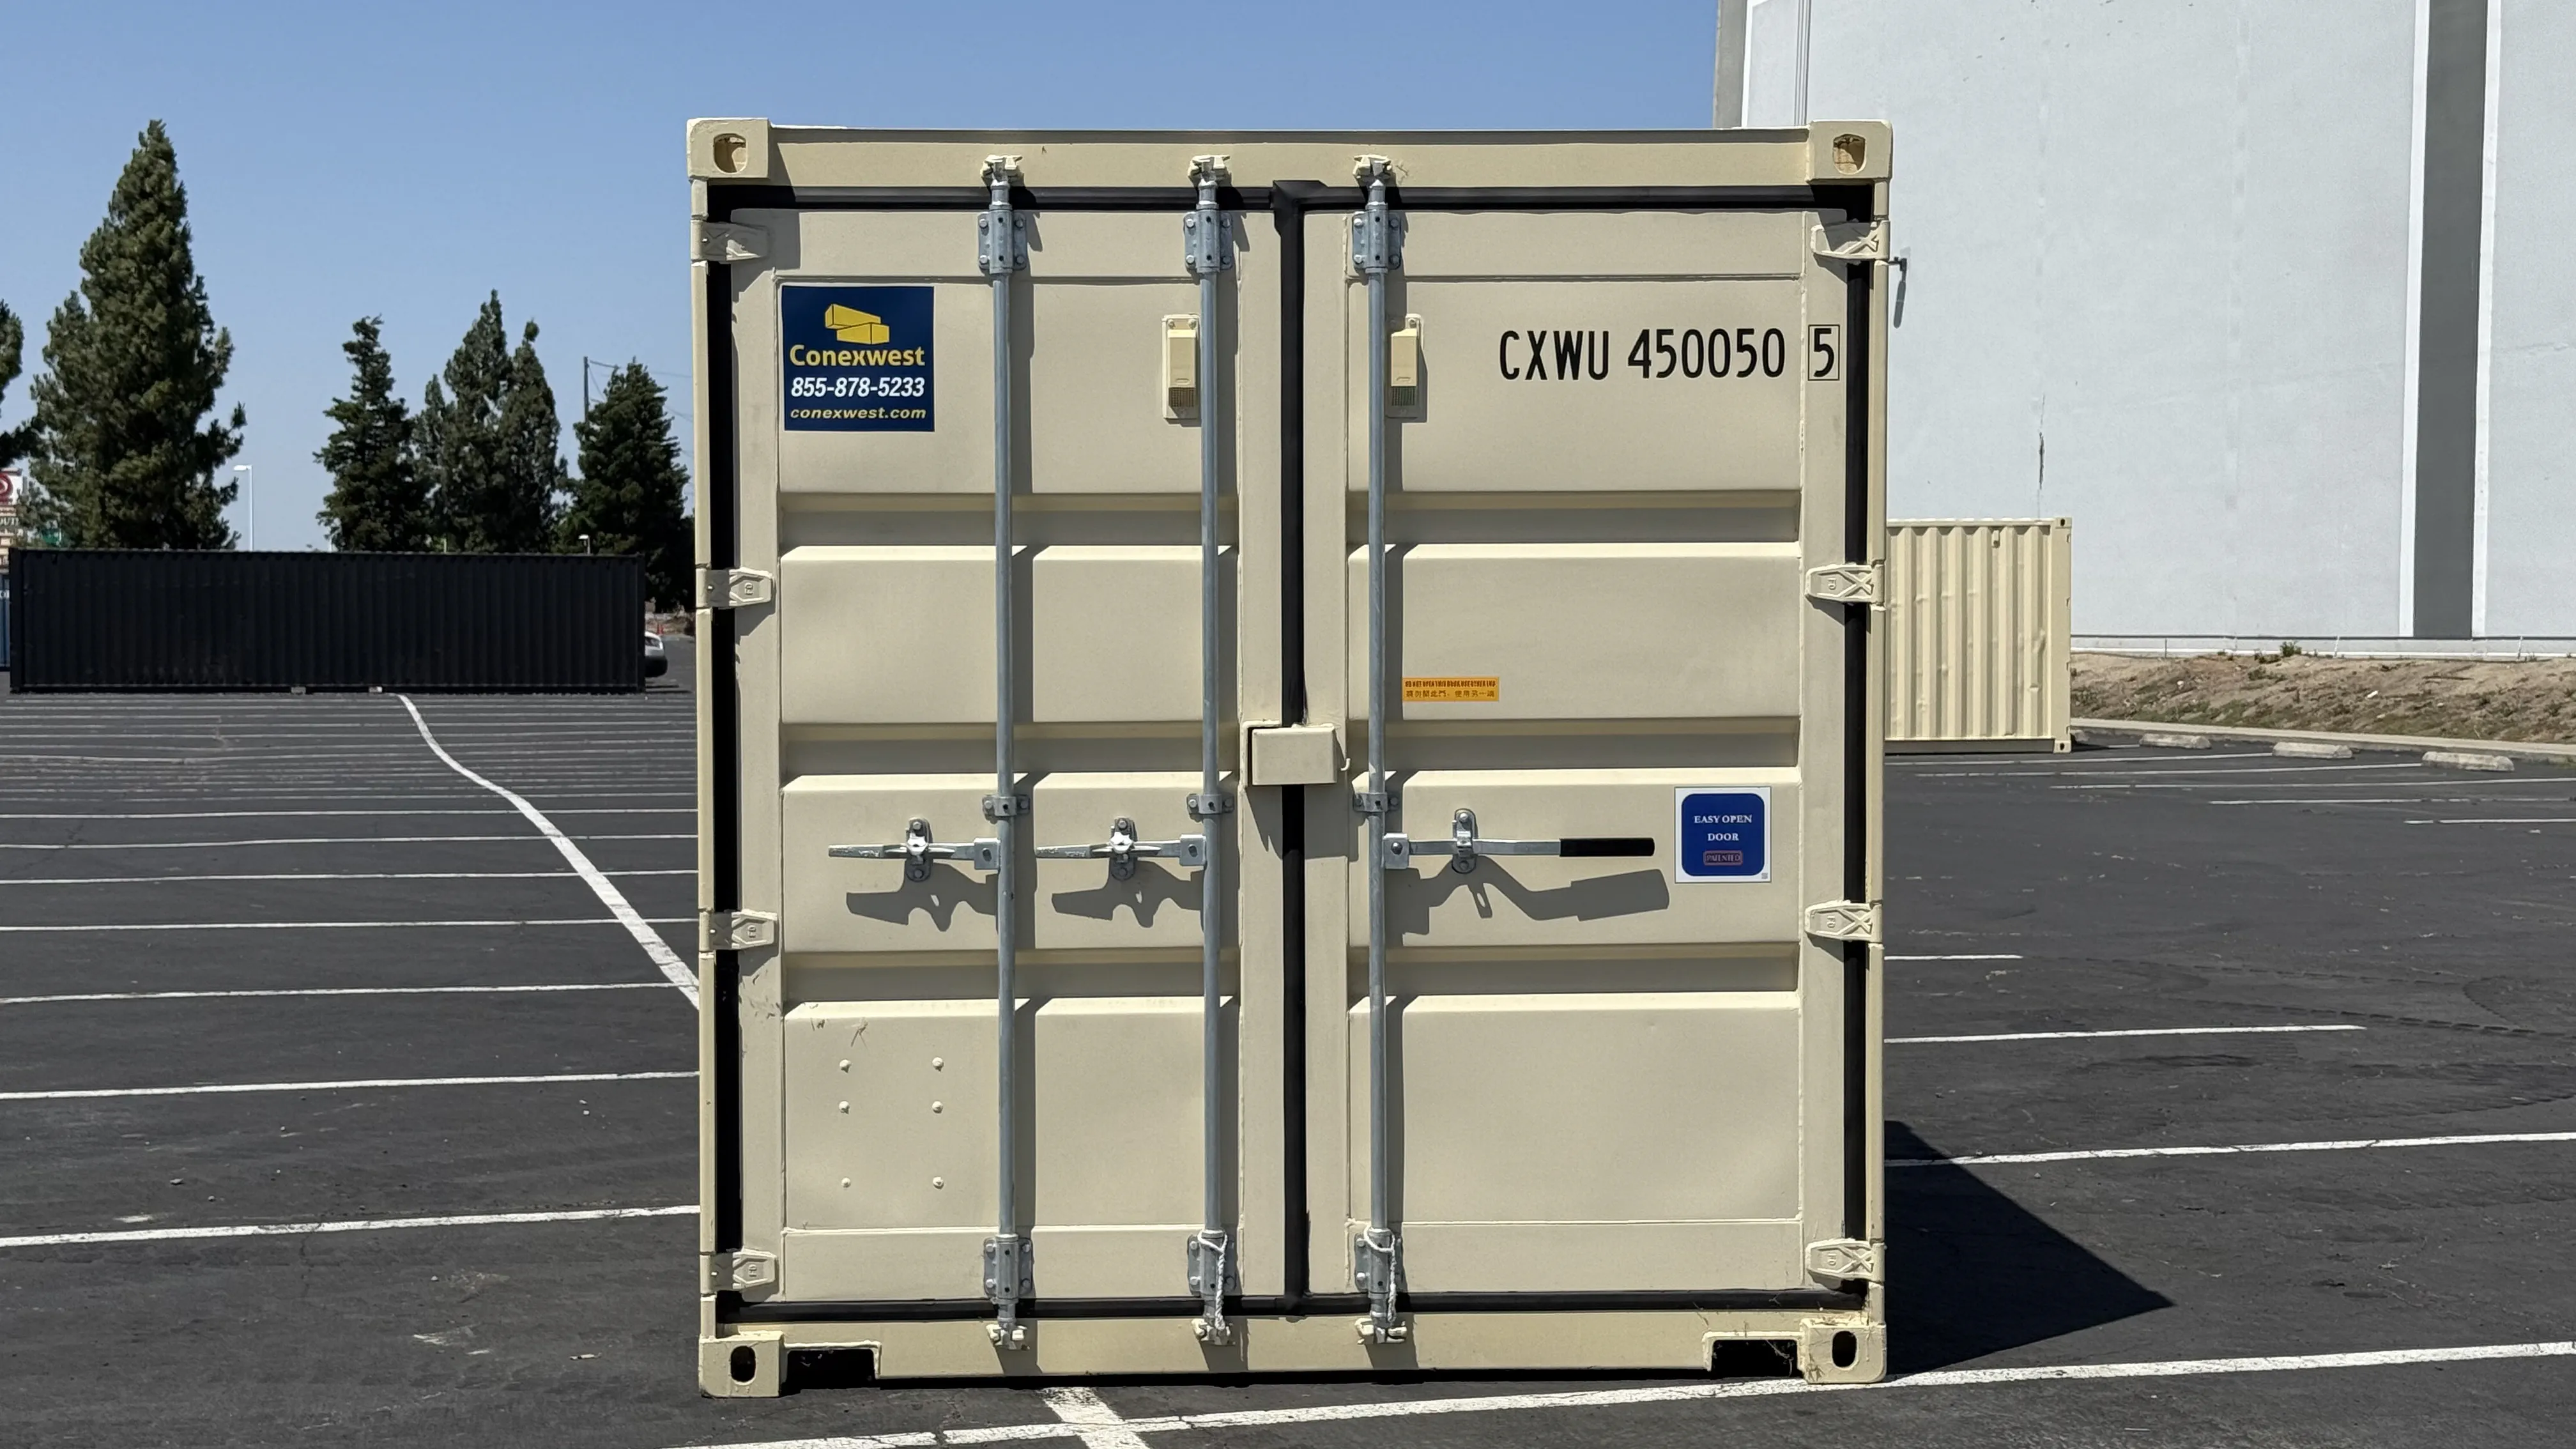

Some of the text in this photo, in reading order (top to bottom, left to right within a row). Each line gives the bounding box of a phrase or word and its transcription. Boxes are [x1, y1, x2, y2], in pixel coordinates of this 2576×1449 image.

[790, 344, 926, 367] Conexwest
[1499, 327, 1835, 381] CXWU 450050 5
[791, 377, 925, 397] 855-878-5233
[790, 407, 926, 419] conexwest.com
[1694, 814, 1752, 824] EASY OPEN
[1707, 832, 1739, 841] DOOR
